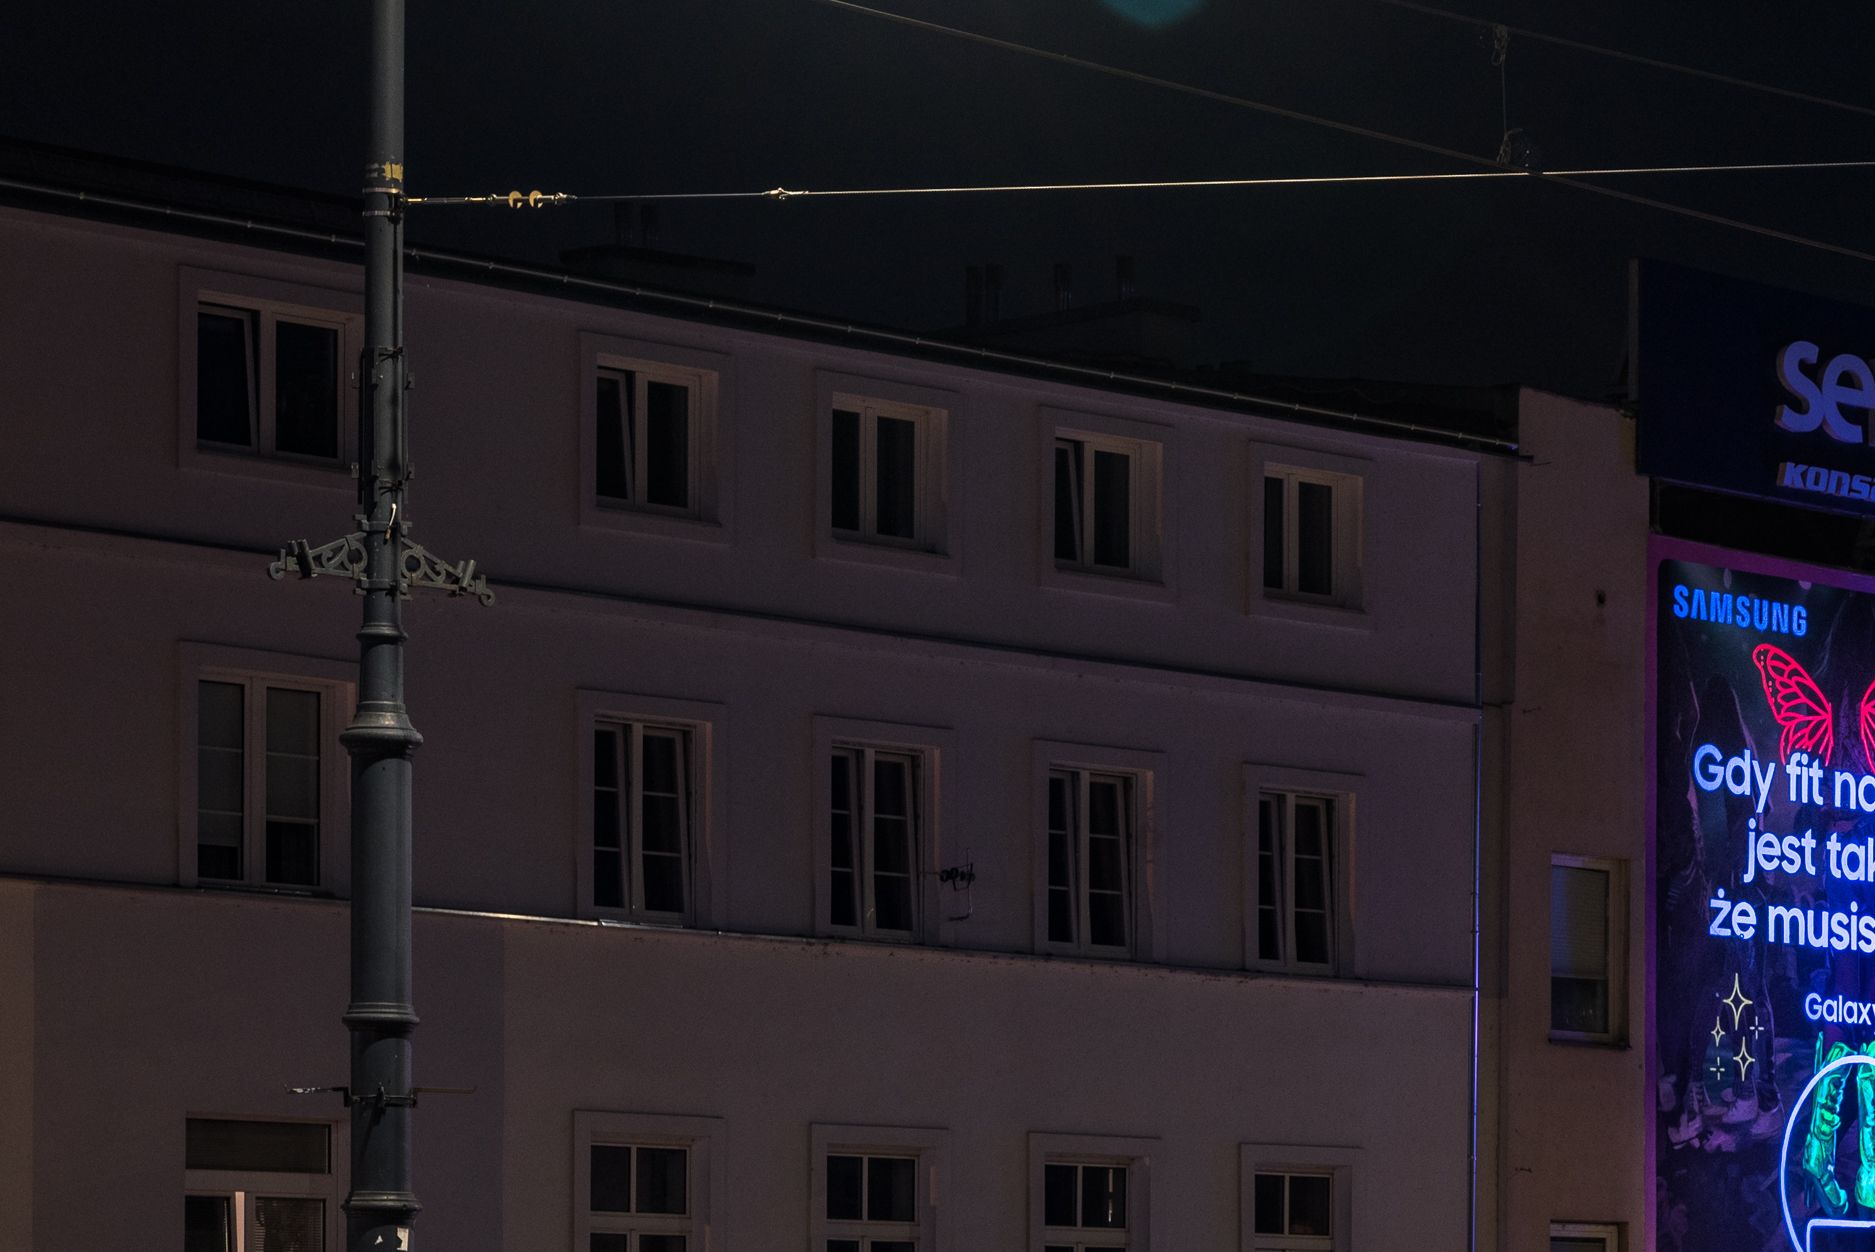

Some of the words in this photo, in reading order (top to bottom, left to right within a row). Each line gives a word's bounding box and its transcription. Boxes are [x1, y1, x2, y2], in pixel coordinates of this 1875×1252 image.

[1673, 584, 1808, 637] SAMSUNG
[1694, 743, 1776, 813] Gdy
[1785, 752, 1824, 806] fit
[1743, 817, 1816, 884] jest
